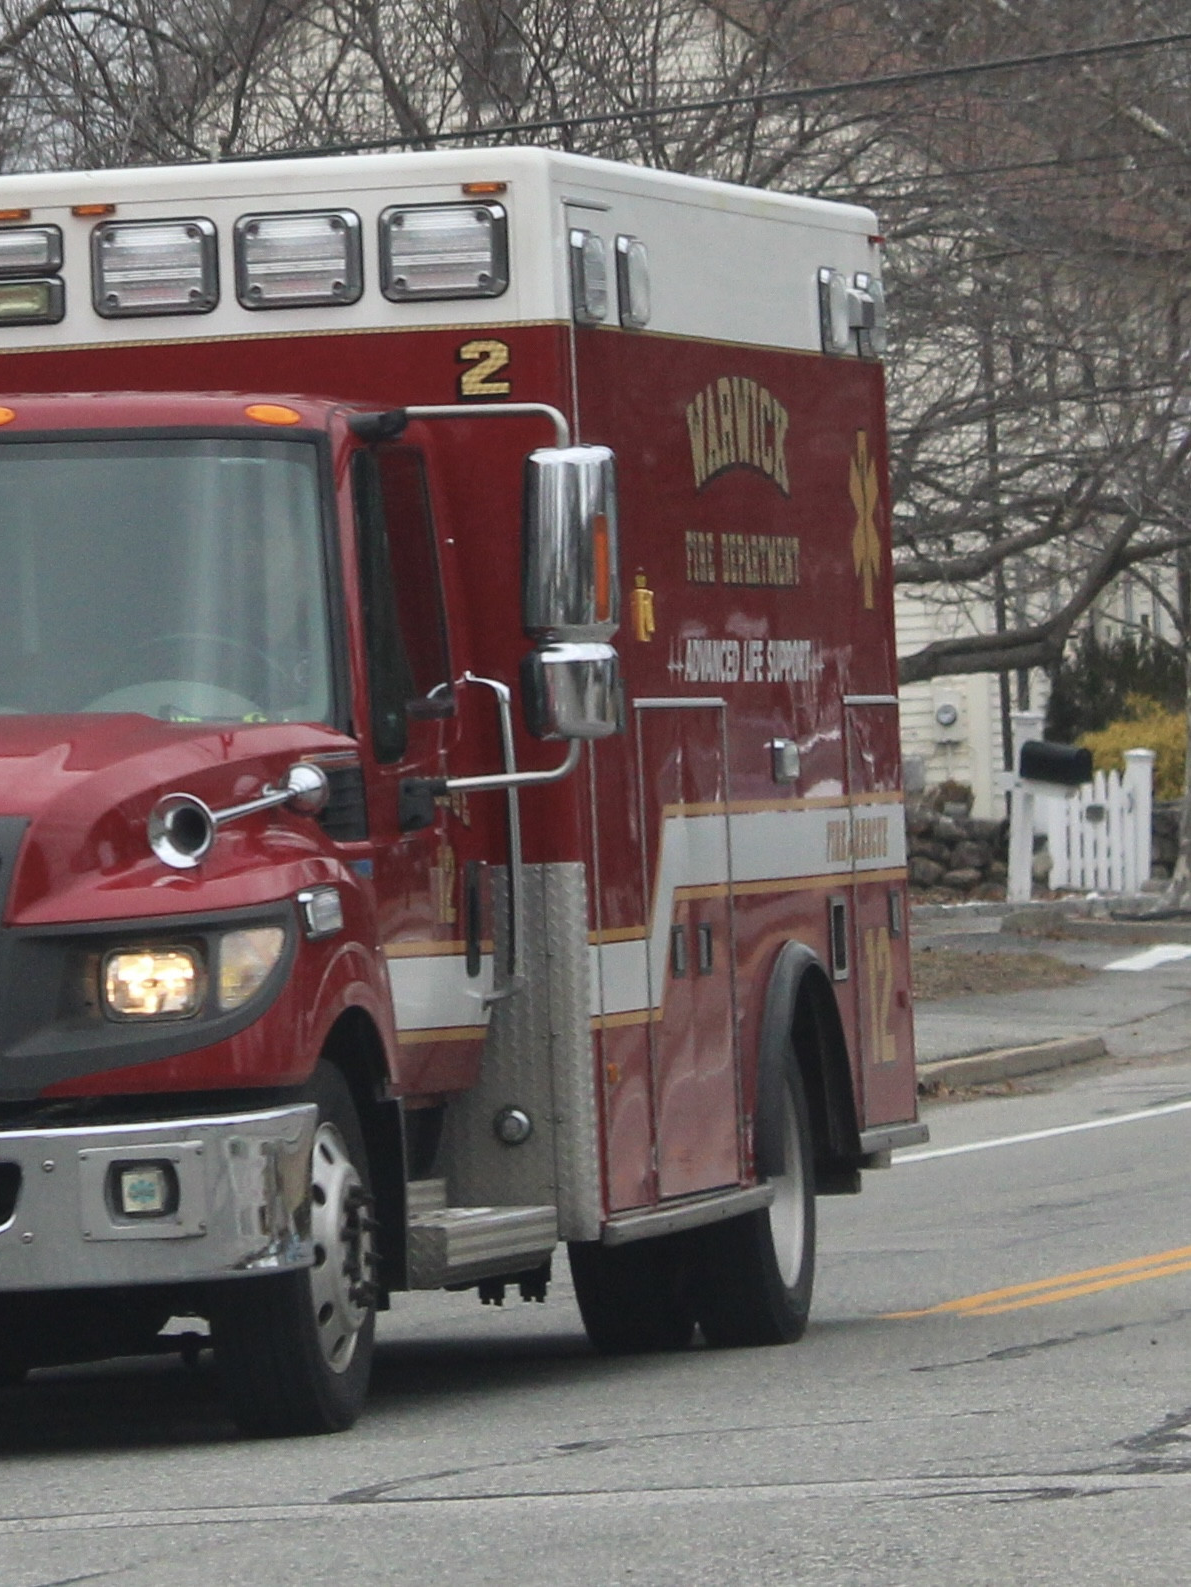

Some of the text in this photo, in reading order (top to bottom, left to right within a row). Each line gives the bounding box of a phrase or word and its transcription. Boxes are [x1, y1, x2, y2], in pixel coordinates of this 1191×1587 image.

[458, 339, 510, 397] 2
[686, 376, 791, 497] WARWICK
[743, 639, 764, 682] LIFE
